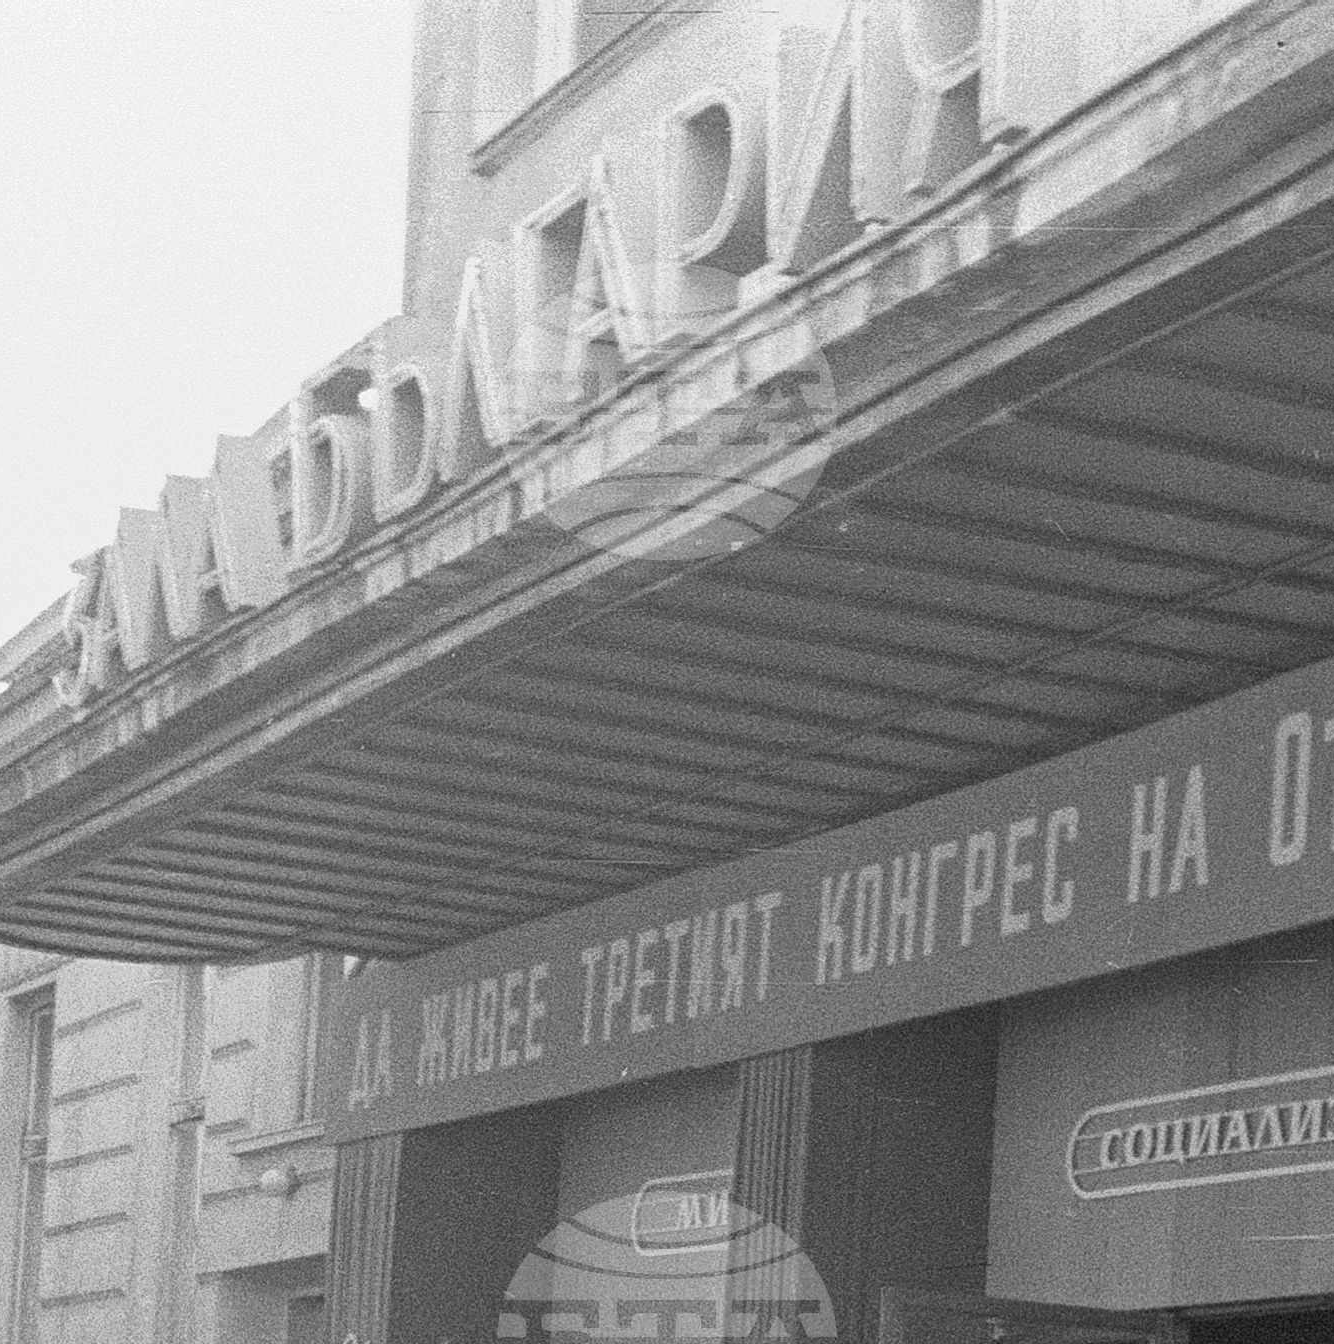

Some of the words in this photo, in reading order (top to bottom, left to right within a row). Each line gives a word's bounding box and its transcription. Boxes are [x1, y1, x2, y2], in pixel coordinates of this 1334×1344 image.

[346, 1006, 394, 1111] ДА
[417, 963, 550, 1087] ЖИВЕЕ
[581, 892, 783, 1046] ТРЕТИЯТ
[815, 806, 1080, 987] КОНГРЕС
[1127, 765, 1210, 902] НА
[676, 1188, 729, 1231] МИ
